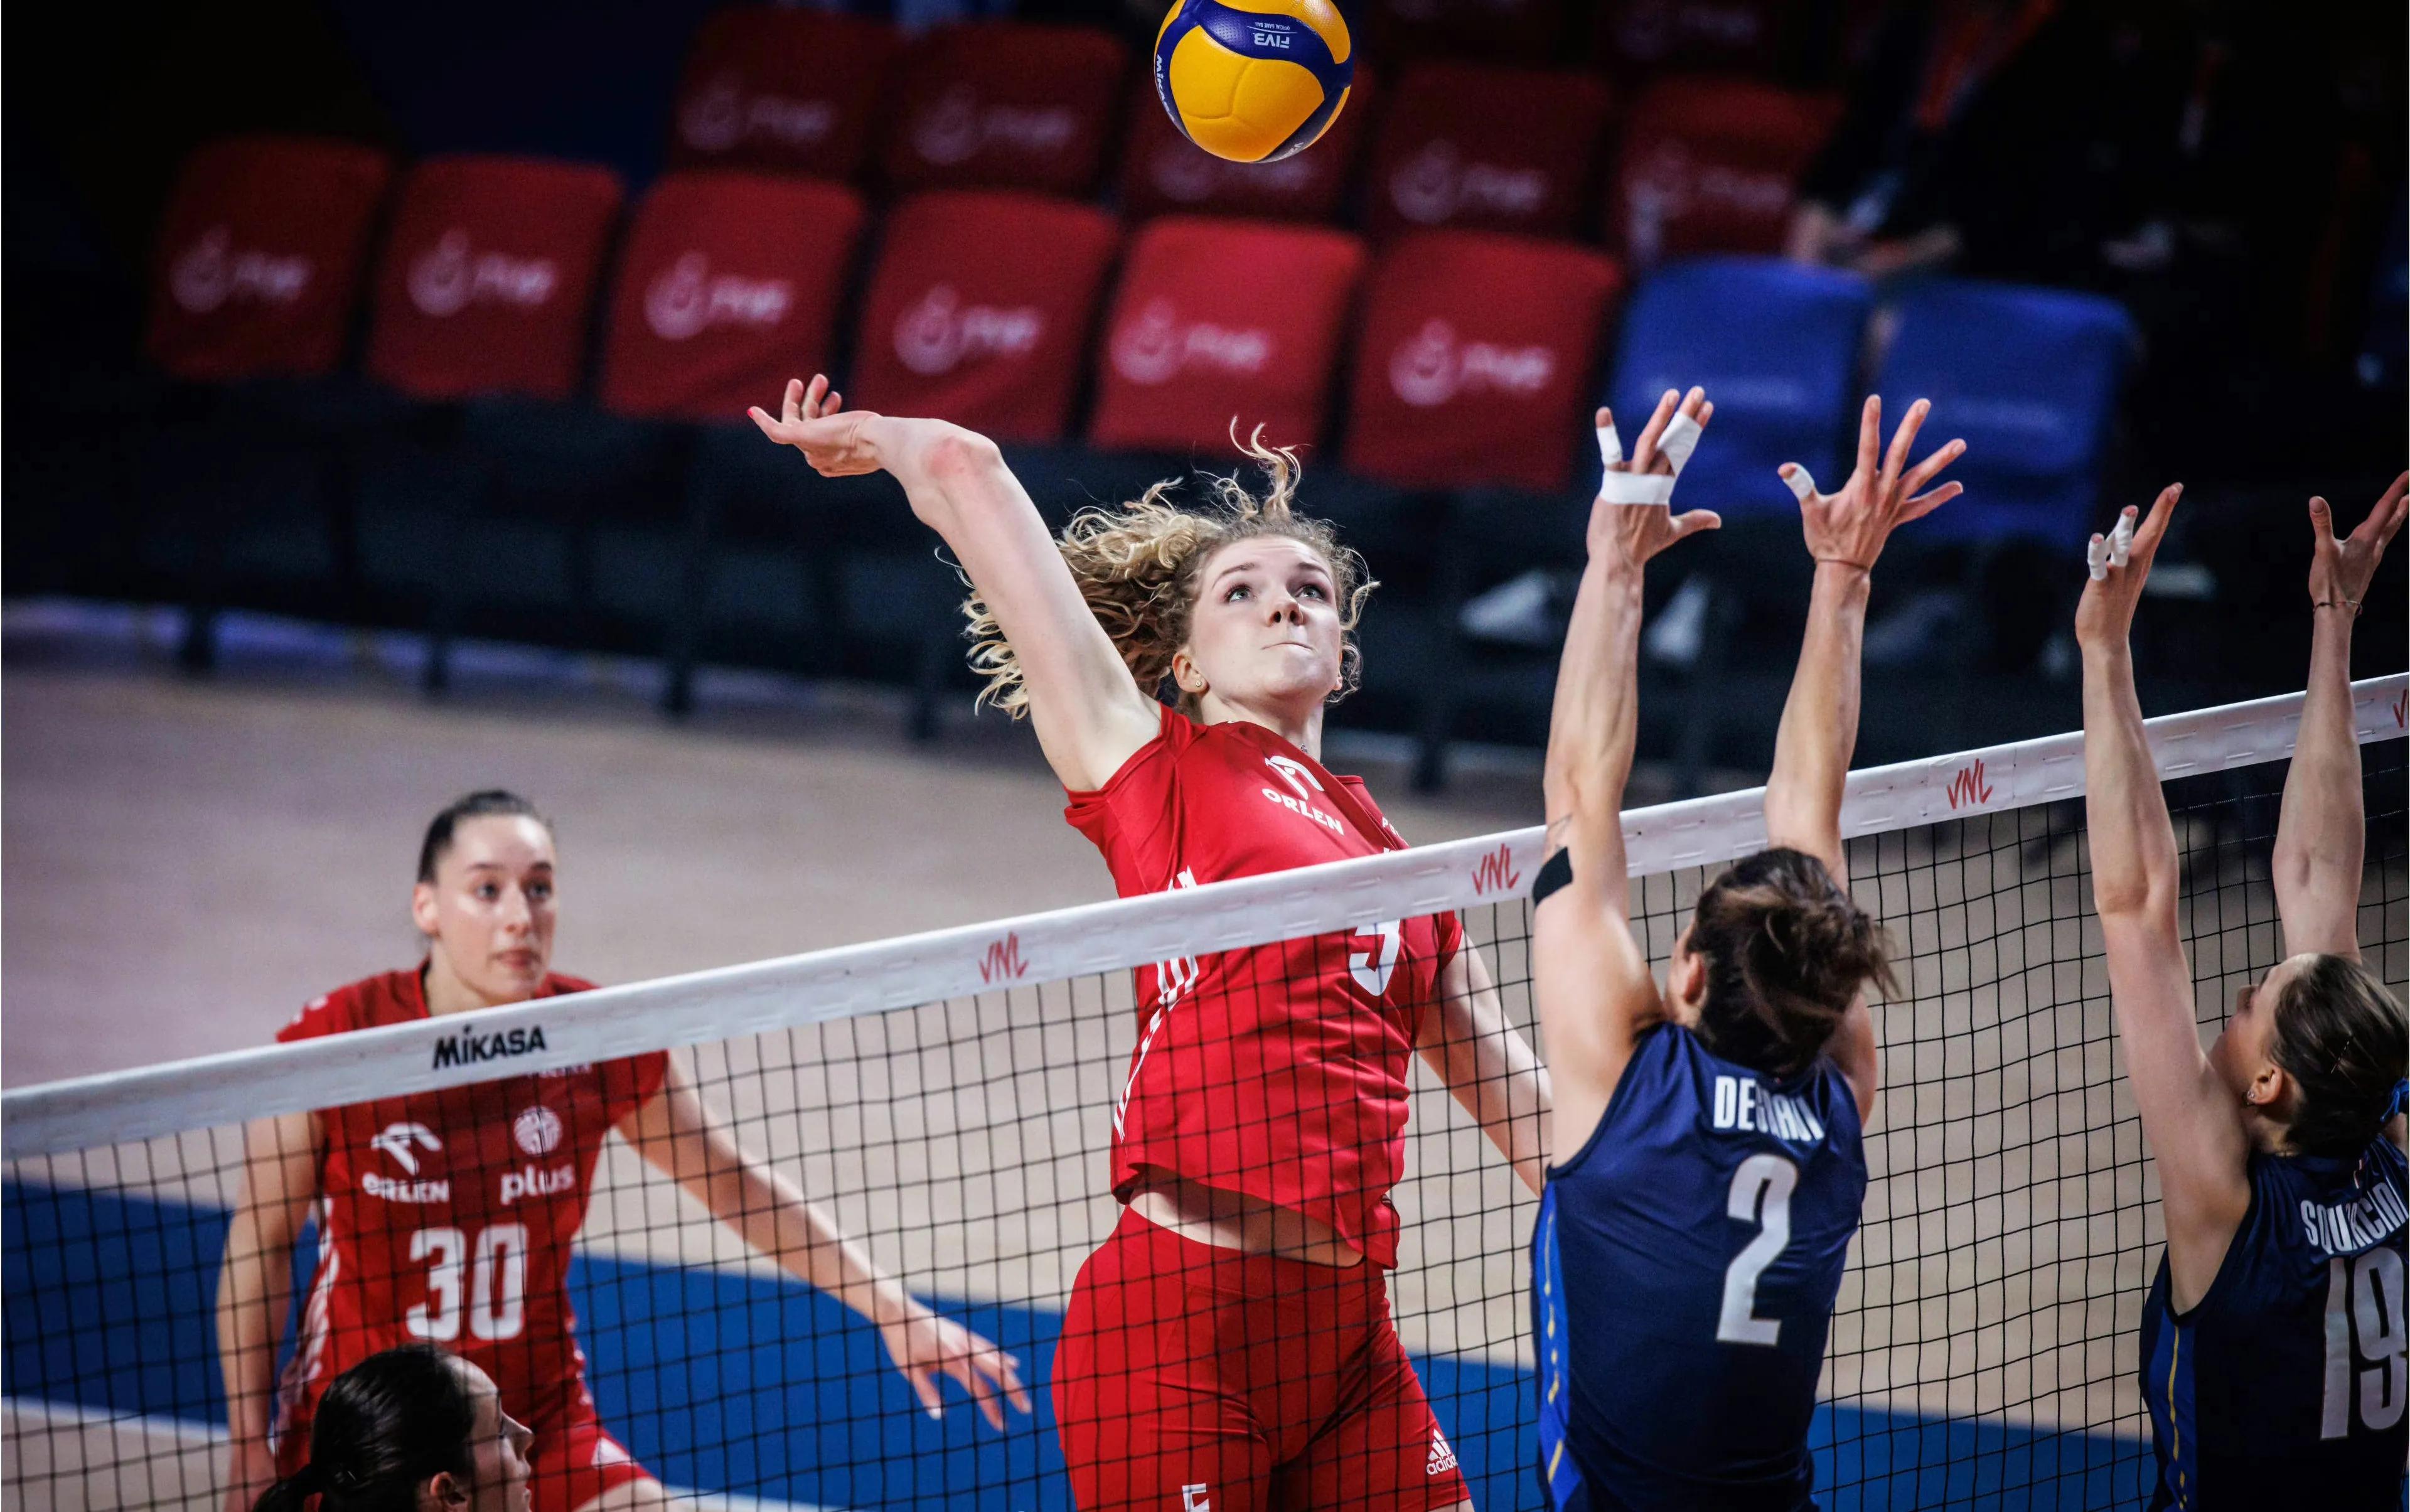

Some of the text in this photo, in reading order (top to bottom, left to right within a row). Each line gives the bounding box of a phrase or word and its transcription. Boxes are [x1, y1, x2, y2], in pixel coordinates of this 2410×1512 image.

[1947, 758, 1993, 810] VNL
[1261, 788, 1344, 835] ORLEN
[1471, 843, 1520, 896] VNL
[978, 931, 1029, 985] VNL
[500, 1164, 576, 1206] plus
[1716, 1153, 1799, 1346] 2
[405, 1223, 528, 1343] 30
[2320, 1247, 2408, 1440] 19
[1426, 1452, 1459, 1475] adida
